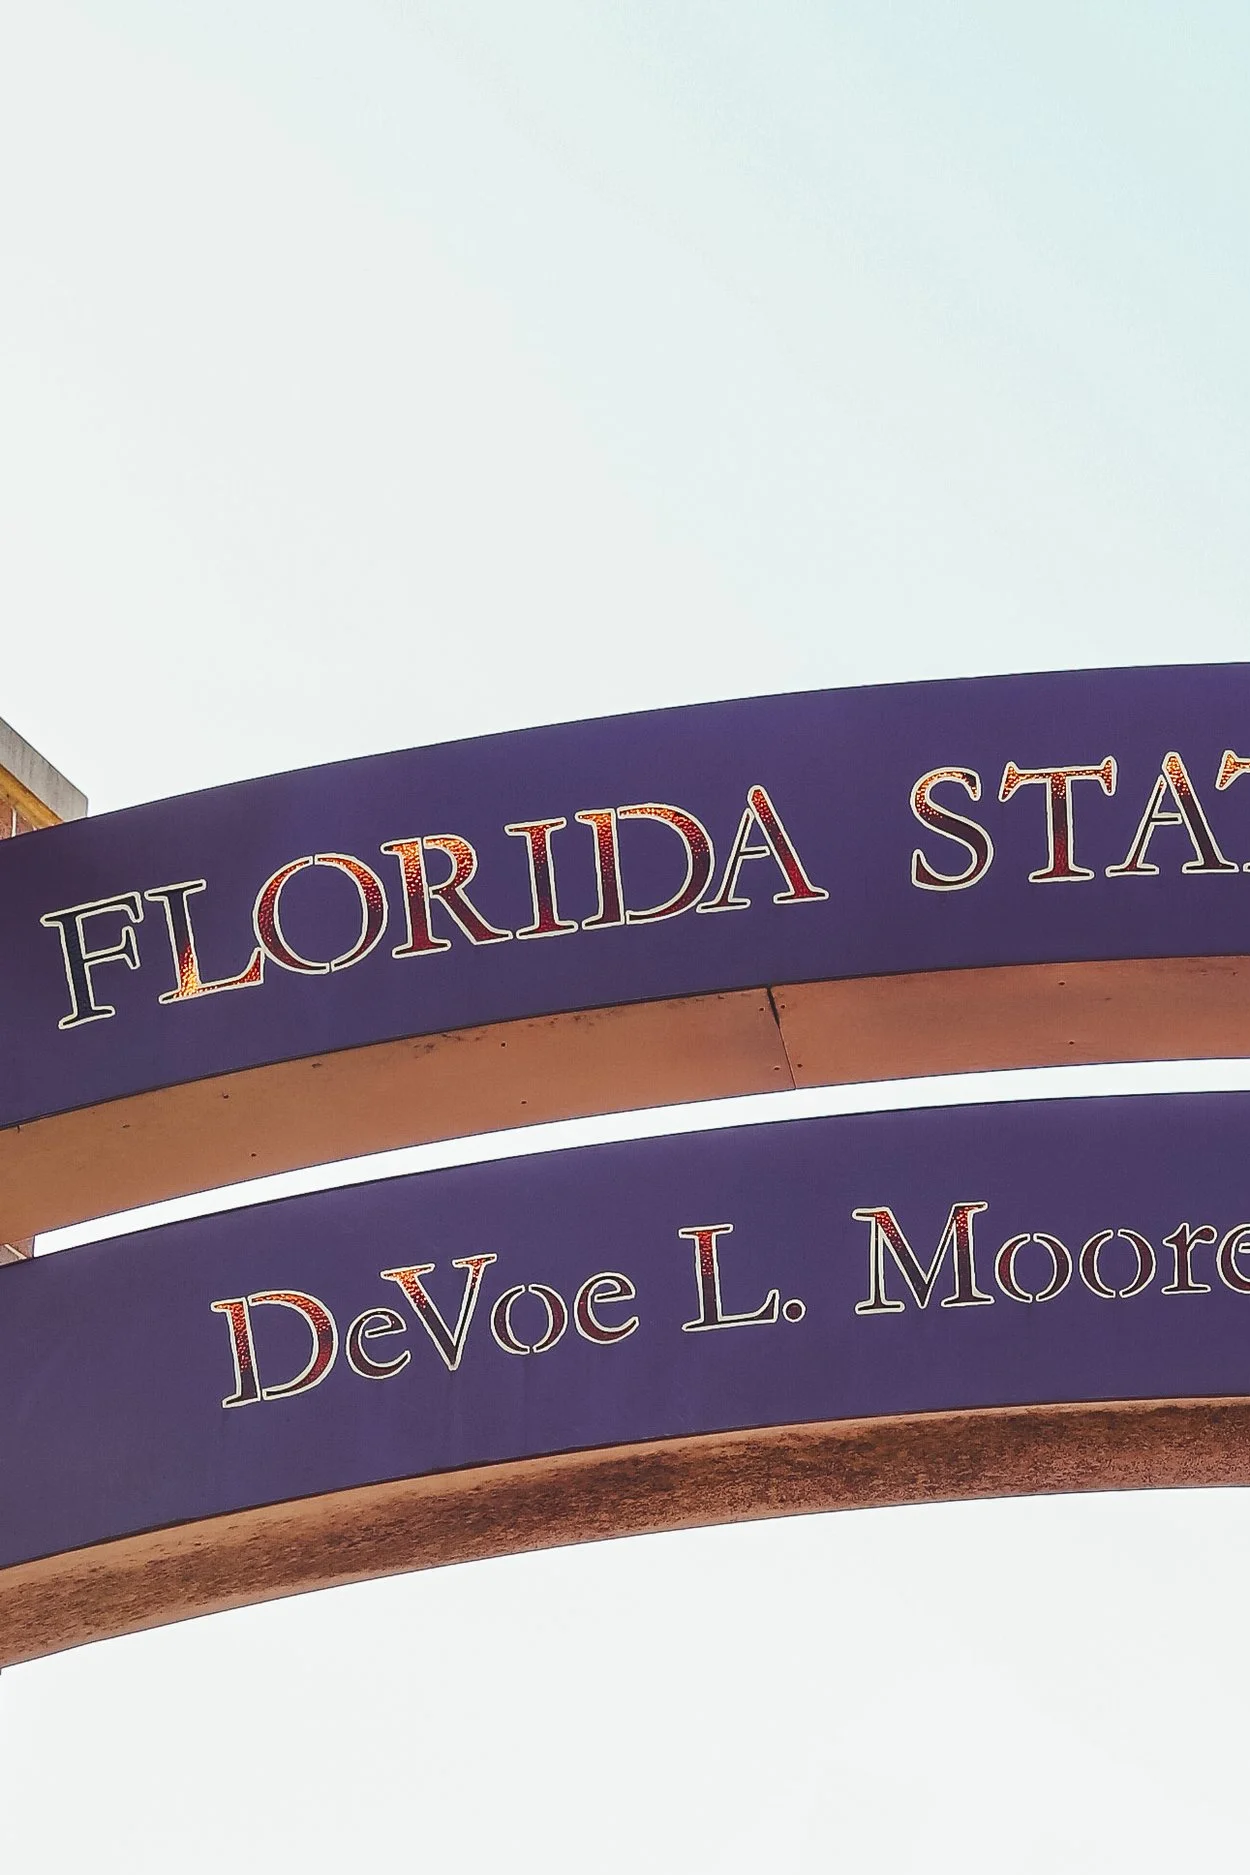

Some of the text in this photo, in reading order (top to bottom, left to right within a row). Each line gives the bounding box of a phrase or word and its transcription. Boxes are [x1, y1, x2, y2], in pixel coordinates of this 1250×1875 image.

[41, 784, 829, 1030] FLORIDA
[211, 1254, 639, 1408] DeVoe
[679, 1224, 806, 1333] L.
